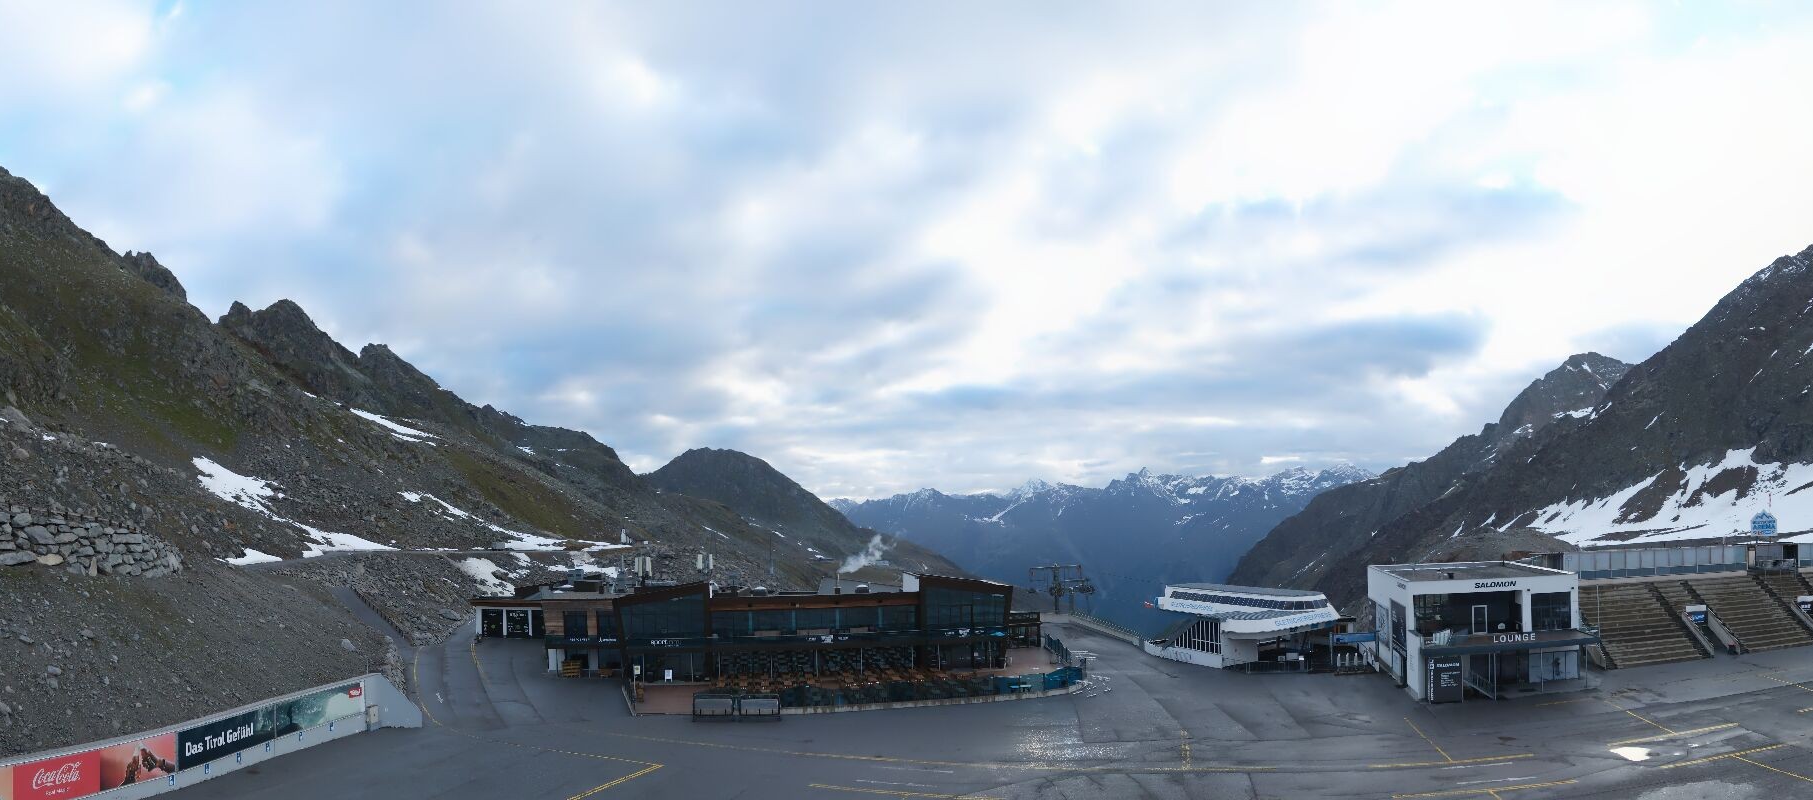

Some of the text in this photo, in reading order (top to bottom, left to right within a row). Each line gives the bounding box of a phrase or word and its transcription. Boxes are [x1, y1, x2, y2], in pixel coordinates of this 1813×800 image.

[1474, 580, 1517, 589] SALOMON
[1493, 633, 1536, 643] LOUNGE
[185, 722, 254, 757] Das Tirol Gefühl
